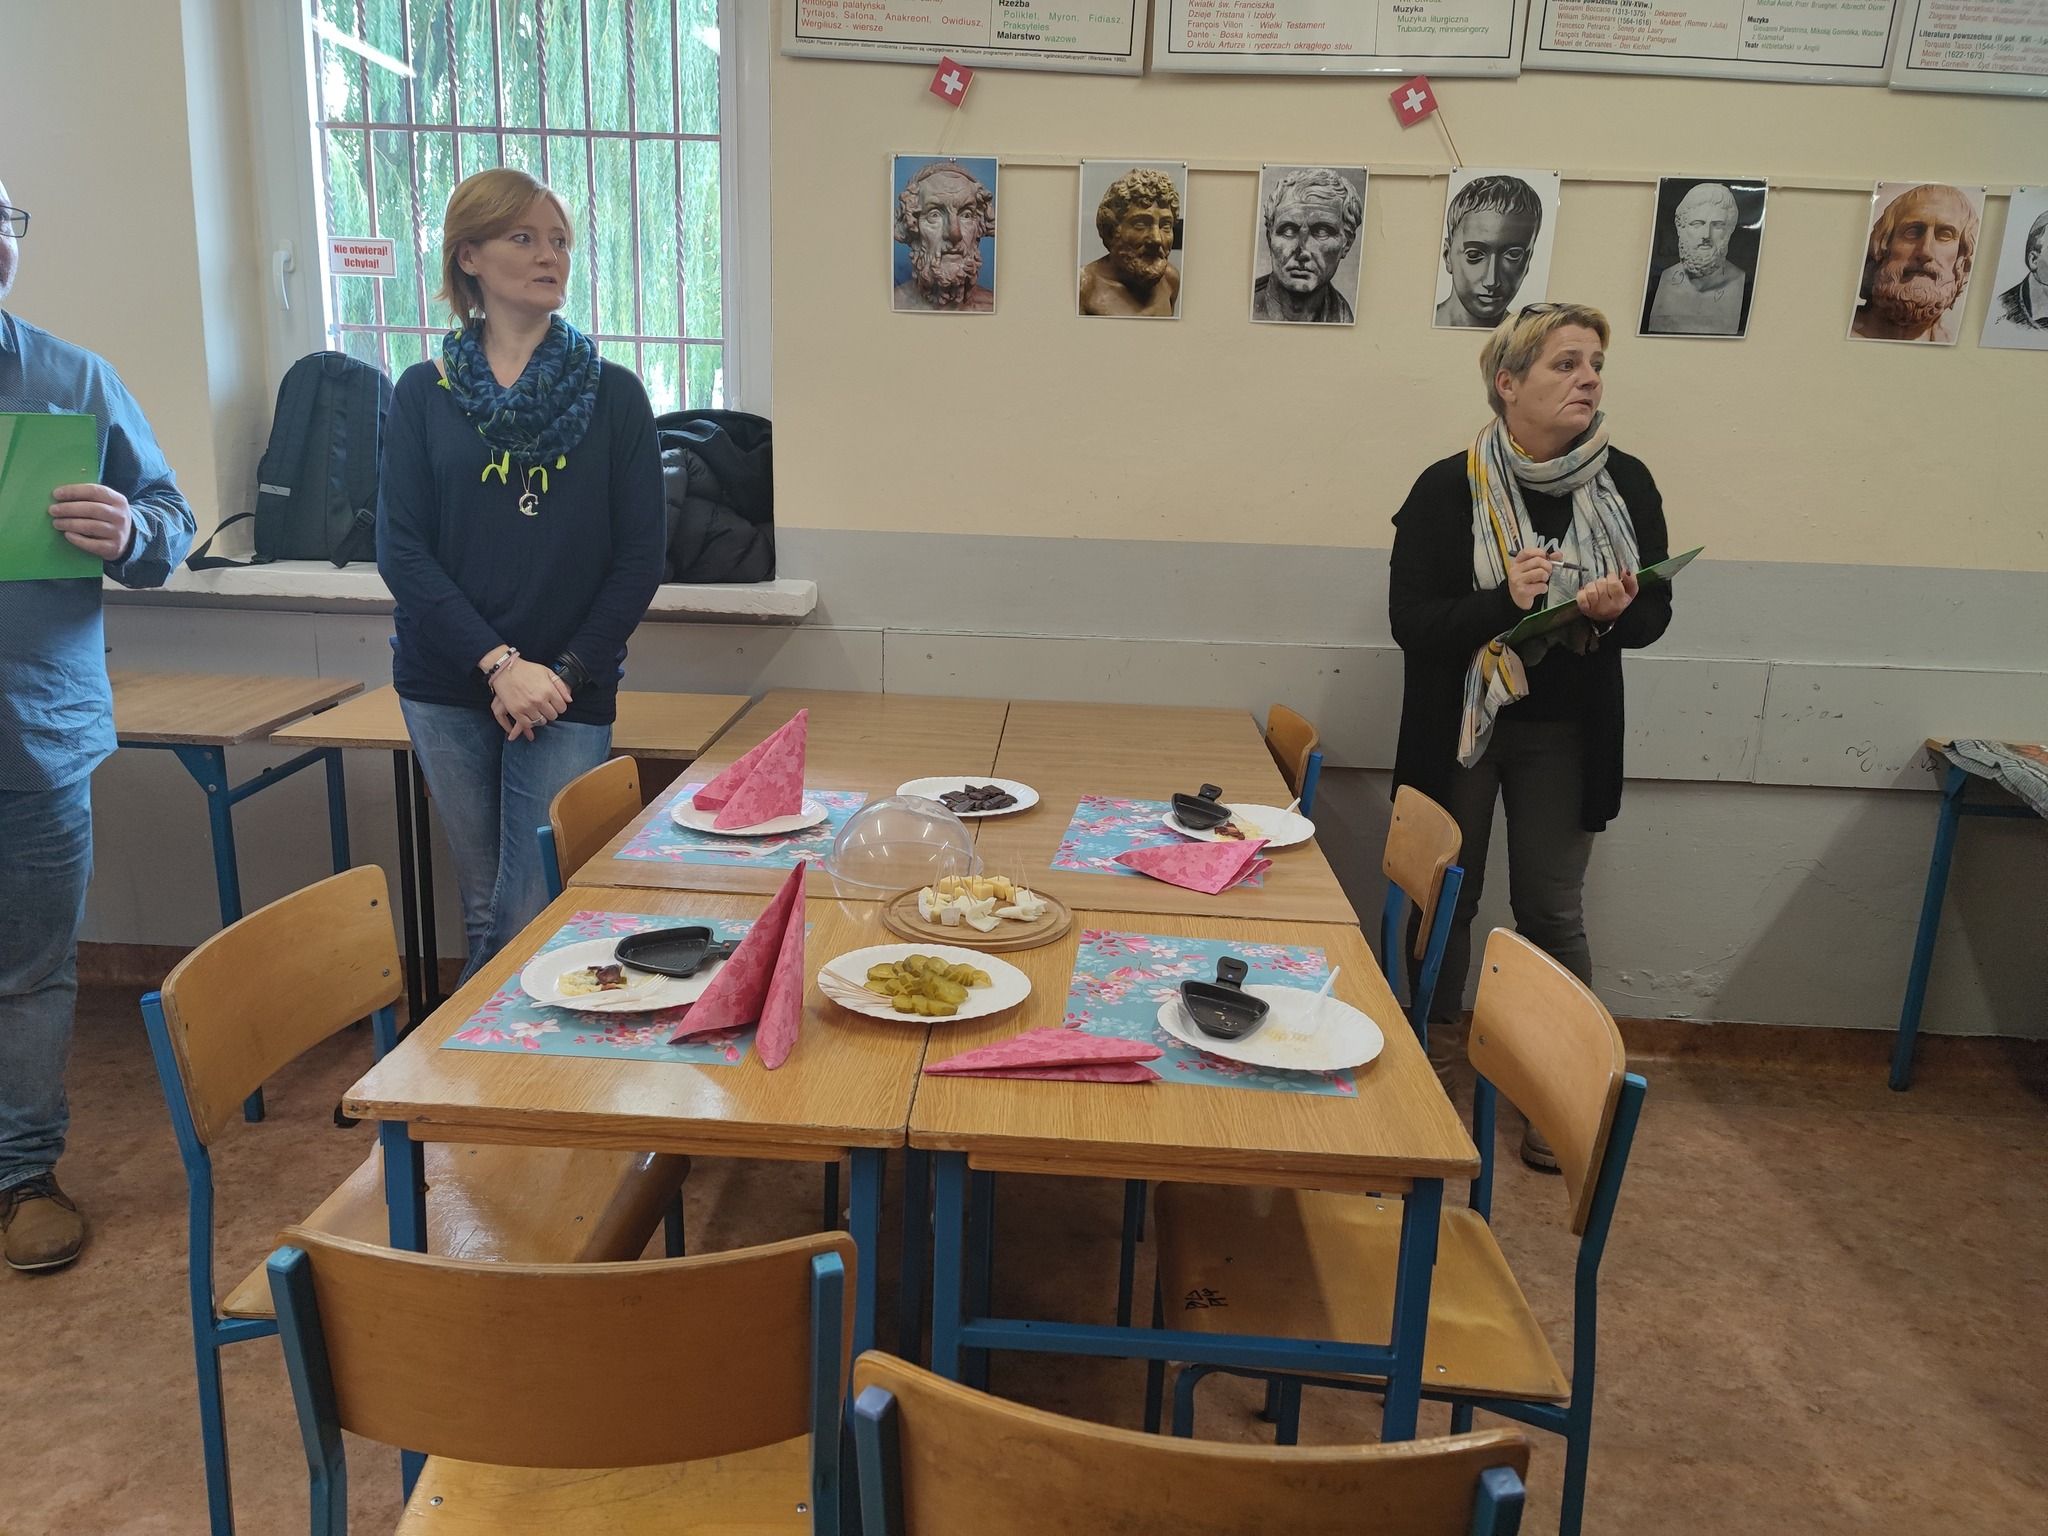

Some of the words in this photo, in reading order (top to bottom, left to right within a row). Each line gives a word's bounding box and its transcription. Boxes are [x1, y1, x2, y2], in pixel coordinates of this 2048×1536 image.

[1188, 0, 1216, 8] Kwiatki
[1234, 1, 1275, 9] Franciszka
[1558, 3, 1583, 11] Giovanni
[1392, 5, 1424, 14] Muzyka
[1188, 10, 1212, 19] Dzieje
[1215, 10, 1245, 19] Tristana
[1253, 12, 1276, 20] Izoldy
[1397, 15, 1427, 24] Muzyka
[1430, 16, 1469, 24] liturgiczna
[1747, 16, 1769, 24] Muzyka
[801, 18, 842, 30] Wergiliusz
[852, 23, 884, 32] wiersze
[1187, 20, 1220, 30] François
[1223, 20, 1244, 29] Villon
[1259, 21, 1283, 29] Wielki
[1286, 21, 1326, 29] Testament
[1556, 22, 1585, 30] Francesco
[997, 31, 1041, 41] Malarstwo
[1187, 30, 1209, 39] Dante
[1219, 31, 1243, 39] Boska
[1246, 31, 1279, 39] komedia
[1919, 30, 1950, 39] Literatura
[1953, 32, 1992, 41] powszechna
[1187, 40, 1194, 48] O
[1197, 40, 1216, 48] królu
[1218, 40, 1245, 49] Arturze
[1253, 42, 1291, 51] rycerzach
[1584, 40, 1612, 49] Cervantes
[334, 244, 348, 254] Nie
[349, 245, 388, 256] otwieraj!
[344, 257, 380, 269] Uchylaj!
